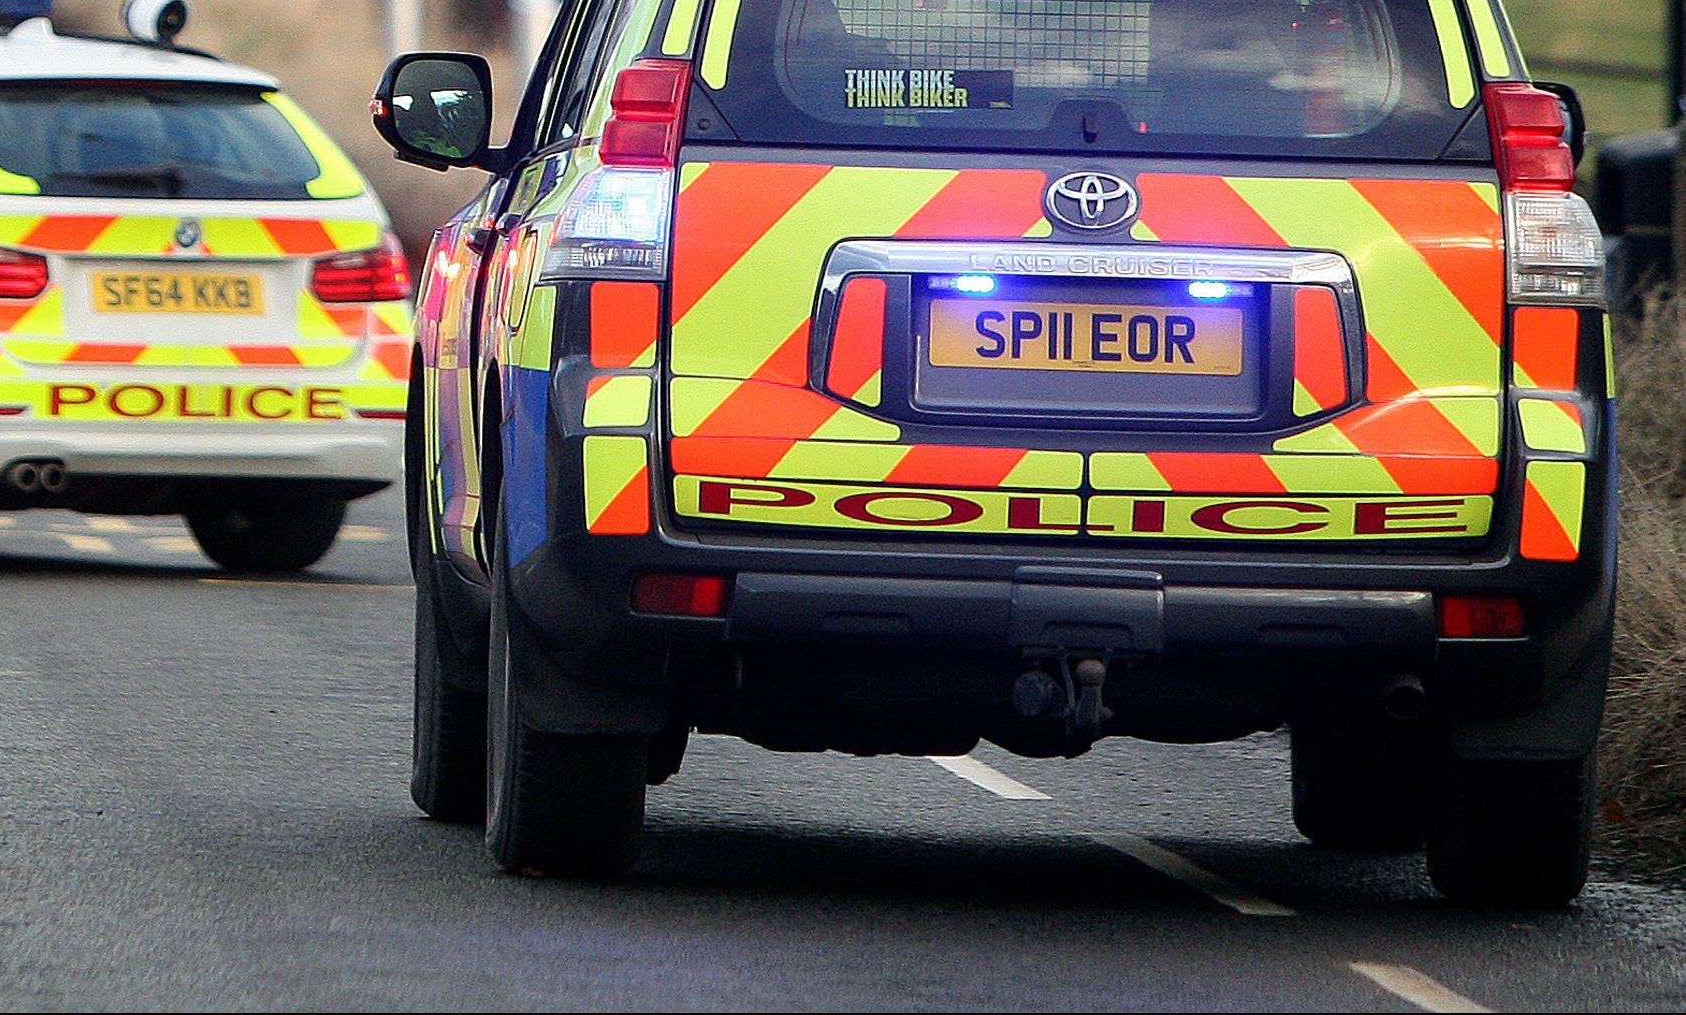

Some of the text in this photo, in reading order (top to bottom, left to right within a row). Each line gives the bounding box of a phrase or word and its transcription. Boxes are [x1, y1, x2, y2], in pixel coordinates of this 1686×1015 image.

[845, 69, 955, 89] THINK BIKE
[844, 88, 968, 108] THINK BIKER
[970, 253, 1213, 276] LAND CRUISER
[103, 276, 251, 309] SF64 KKB
[1090, 312, 1196, 364] EOR
[51, 385, 343, 419] POLICE
[698, 480, 1467, 535] POLICE
